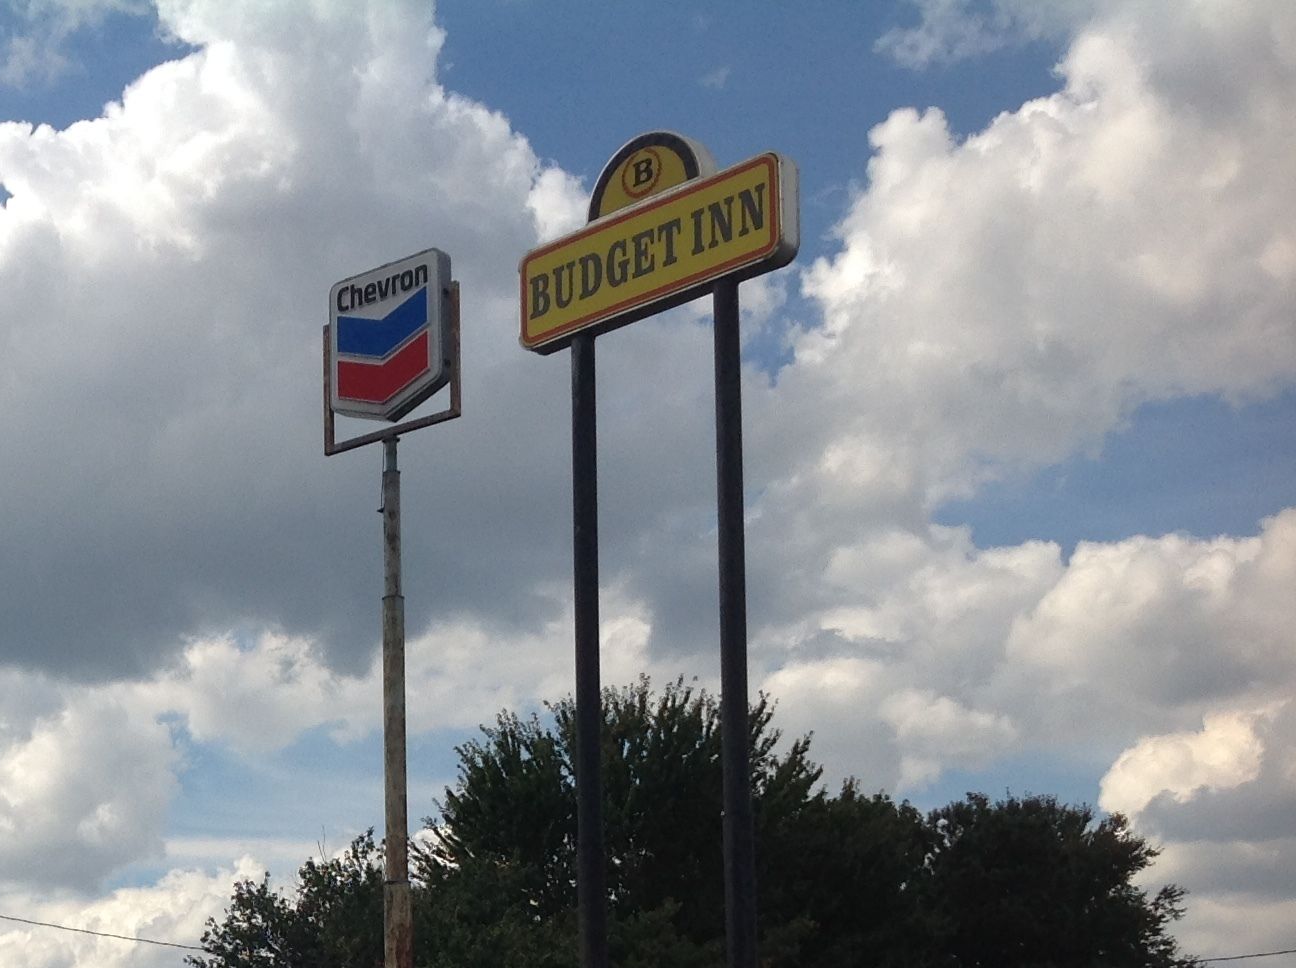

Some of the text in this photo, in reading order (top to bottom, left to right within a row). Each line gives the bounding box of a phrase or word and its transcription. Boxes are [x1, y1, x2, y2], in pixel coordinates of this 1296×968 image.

[633, 158, 653, 188] B
[530, 182, 766, 320] BUDGET INN
[337, 264, 428, 312] Chevron
